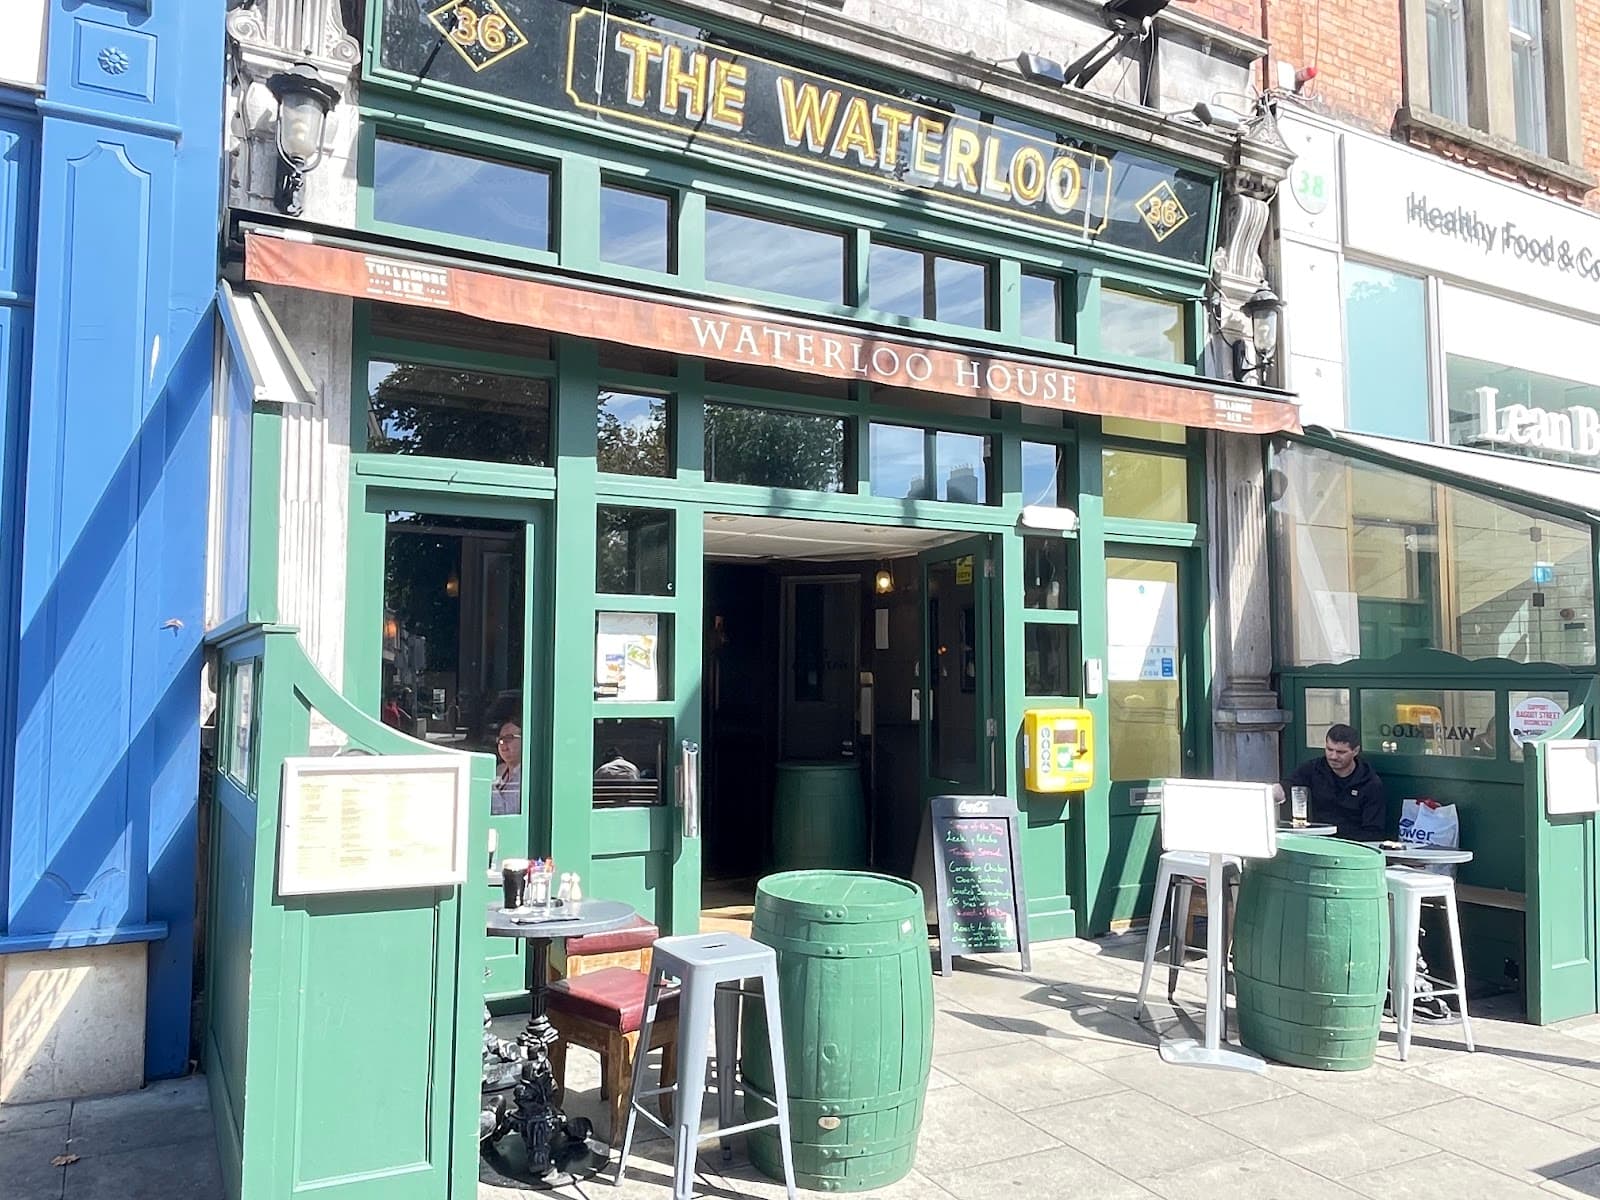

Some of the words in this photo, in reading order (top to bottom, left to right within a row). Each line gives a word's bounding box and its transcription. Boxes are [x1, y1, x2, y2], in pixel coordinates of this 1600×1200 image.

[450, 5, 506, 52] 36
[615, 31, 747, 132] THE
[777, 76, 1082, 215] WATERLOO
[1146, 196, 1177, 227] 36
[1298, 169, 1323, 198] 38
[1406, 188, 1497, 255] Healthy
[1502, 221, 1555, 266] Food
[1558, 240, 1574, 273] &
[365, 262, 448, 286] TULLAMORE
[688, 316, 933, 381] WATERLOO
[956, 360, 1078, 403] HOUSE
[1476, 386, 1574, 452] Lean
